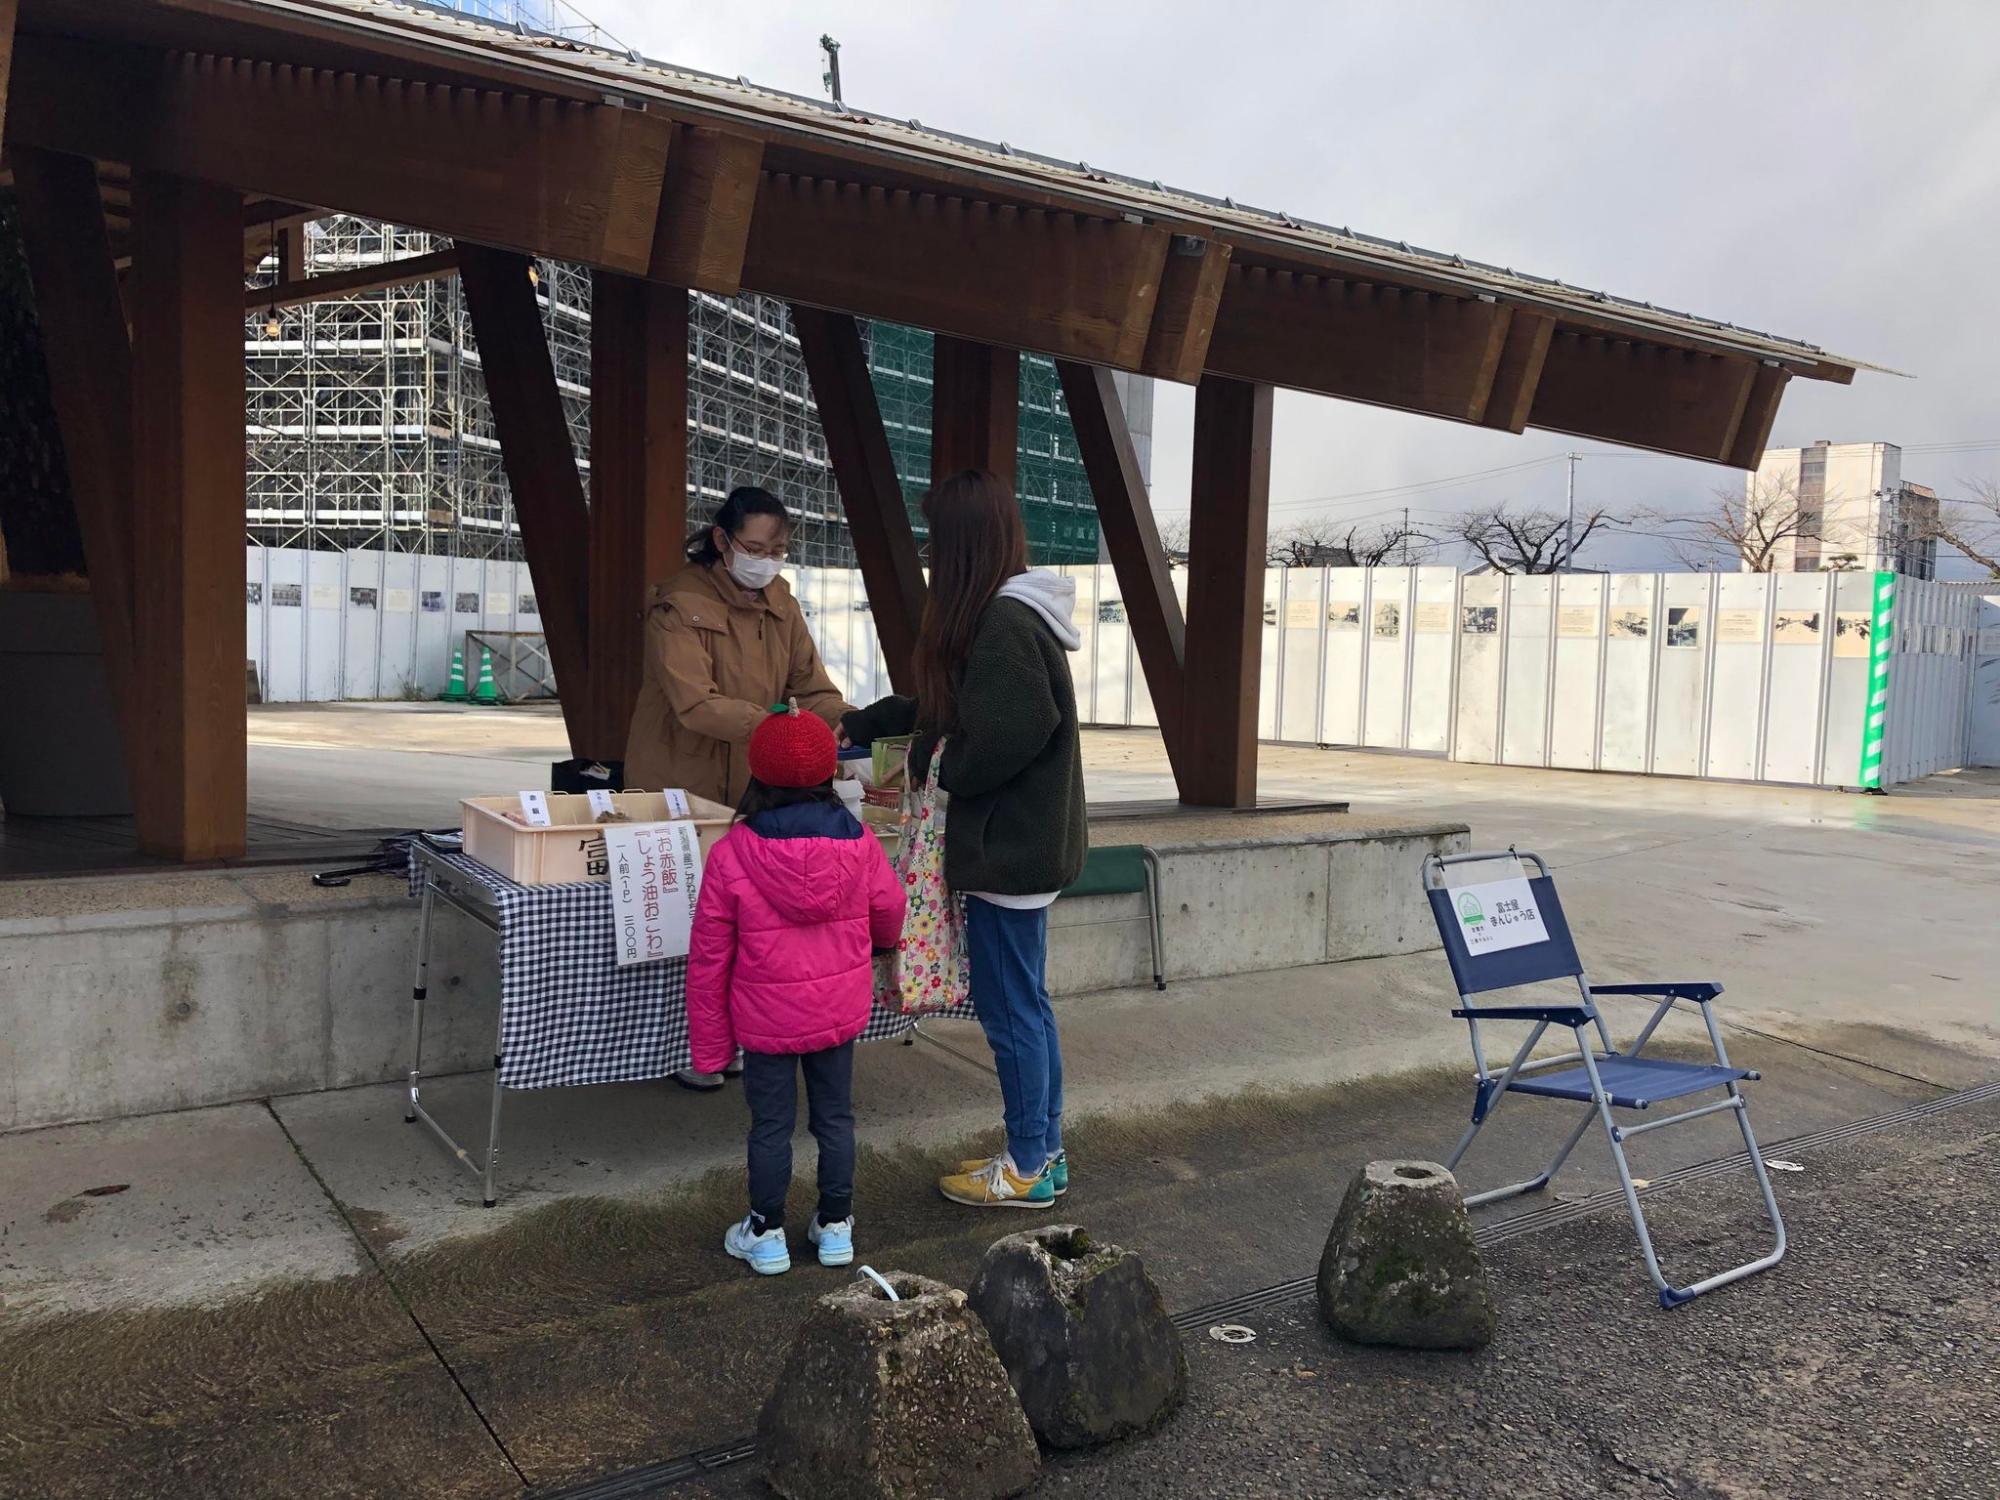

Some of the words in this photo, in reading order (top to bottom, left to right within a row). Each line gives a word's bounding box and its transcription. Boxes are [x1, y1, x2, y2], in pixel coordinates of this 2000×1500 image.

[634, 830, 664, 958] 『しょう油おこわ』
[654, 827, 679, 894] 『お赤飯』
